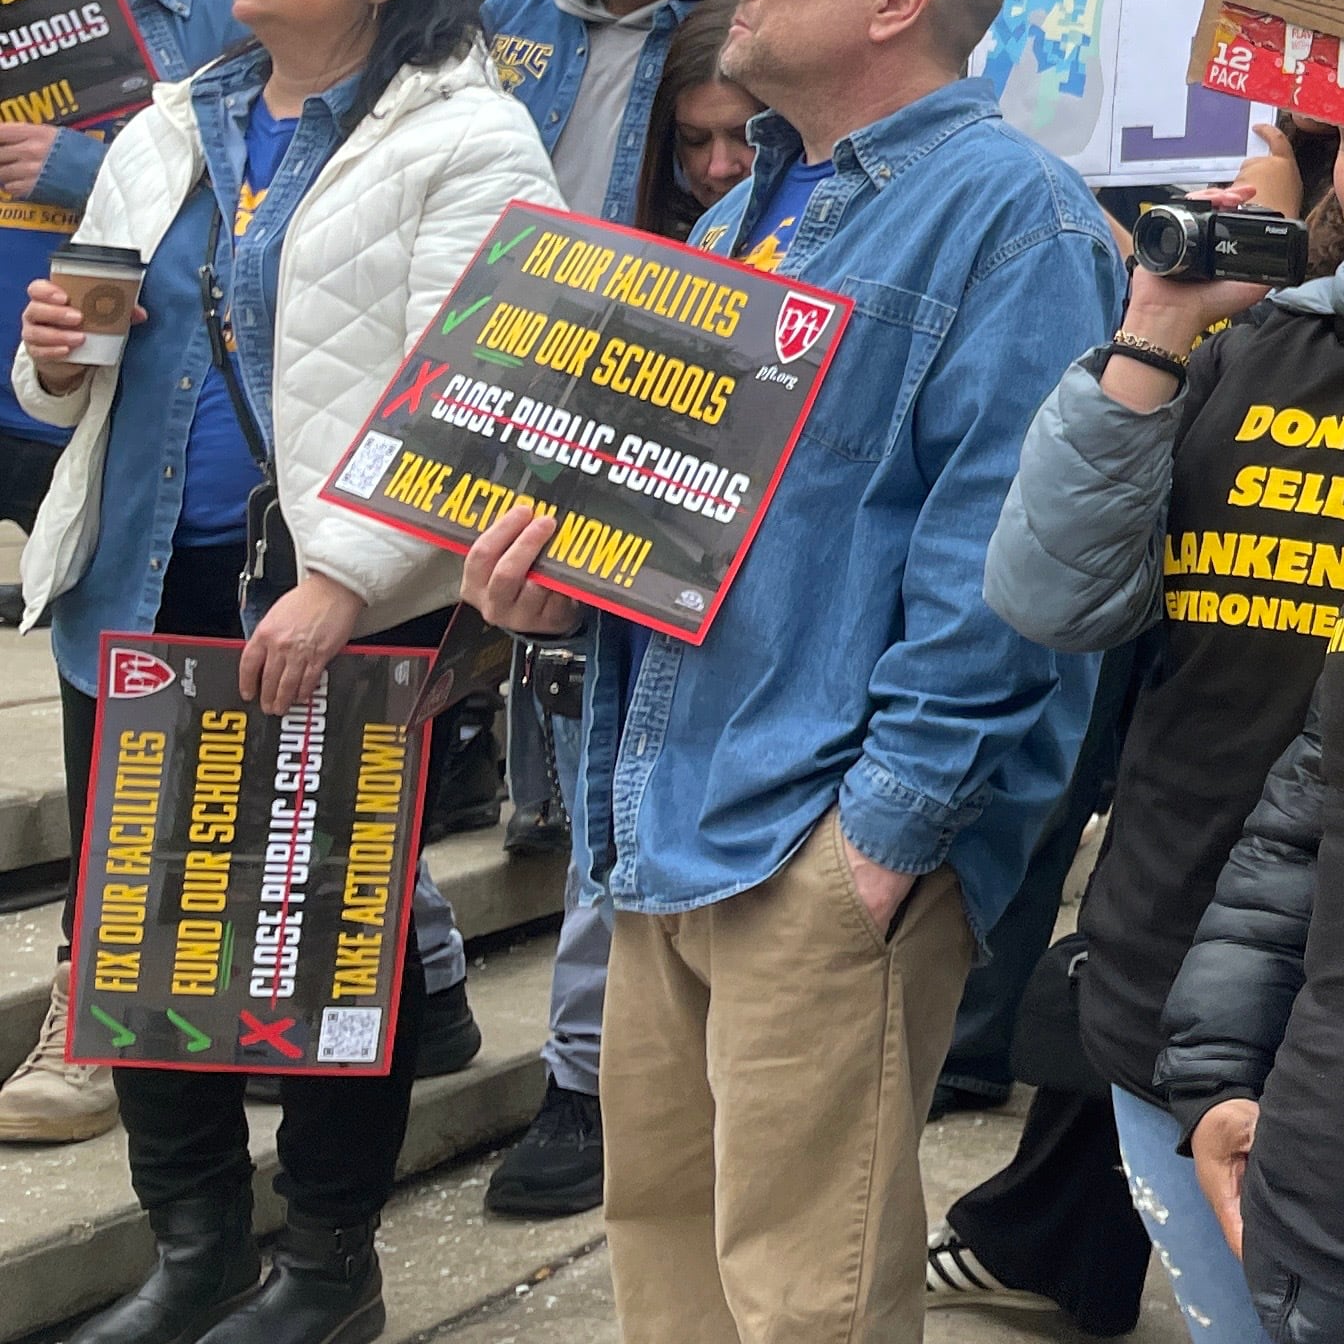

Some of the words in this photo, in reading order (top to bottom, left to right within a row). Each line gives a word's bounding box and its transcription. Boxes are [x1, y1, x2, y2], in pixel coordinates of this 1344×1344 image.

[0, 1, 111, 72] CHOOLS
[1212, 41, 1253, 73] 12
[1208, 66, 1250, 93] PACK
[521, 231, 563, 280] FIX
[558, 239, 611, 296] OUR
[602, 252, 750, 339] FACILITIES
[1215, 239, 1239, 255] 4K
[476, 301, 544, 359] FUND
[534, 319, 601, 378] OUR
[592, 336, 736, 426] SCHOOLS
[778, 305, 820, 354] pft
[754, 362, 799, 390] pft.org
[430, 373, 513, 437] CLOSE
[499, 397, 615, 476] PUBLIC
[607, 433, 751, 524] SCHOOLS
[383, 450, 448, 514] TAKE
[547, 510, 654, 589] NOW!!
[273, 669, 330, 793] SCHOO
[354, 722, 407, 814] NOW!!
[105, 729, 167, 876] FACILITIES
[188, 709, 248, 844] SCHOOLS
[180, 851, 232, 913] OUR
[260, 798, 318, 904] PUBLIC
[340, 822, 397, 927] ACTION
[99, 884, 150, 946] OUR
[248, 909, 305, 1000] CLOSE
[94, 950, 141, 993] FIX
[170, 919, 224, 997] FUND
[331, 932, 383, 1000] TAKE
